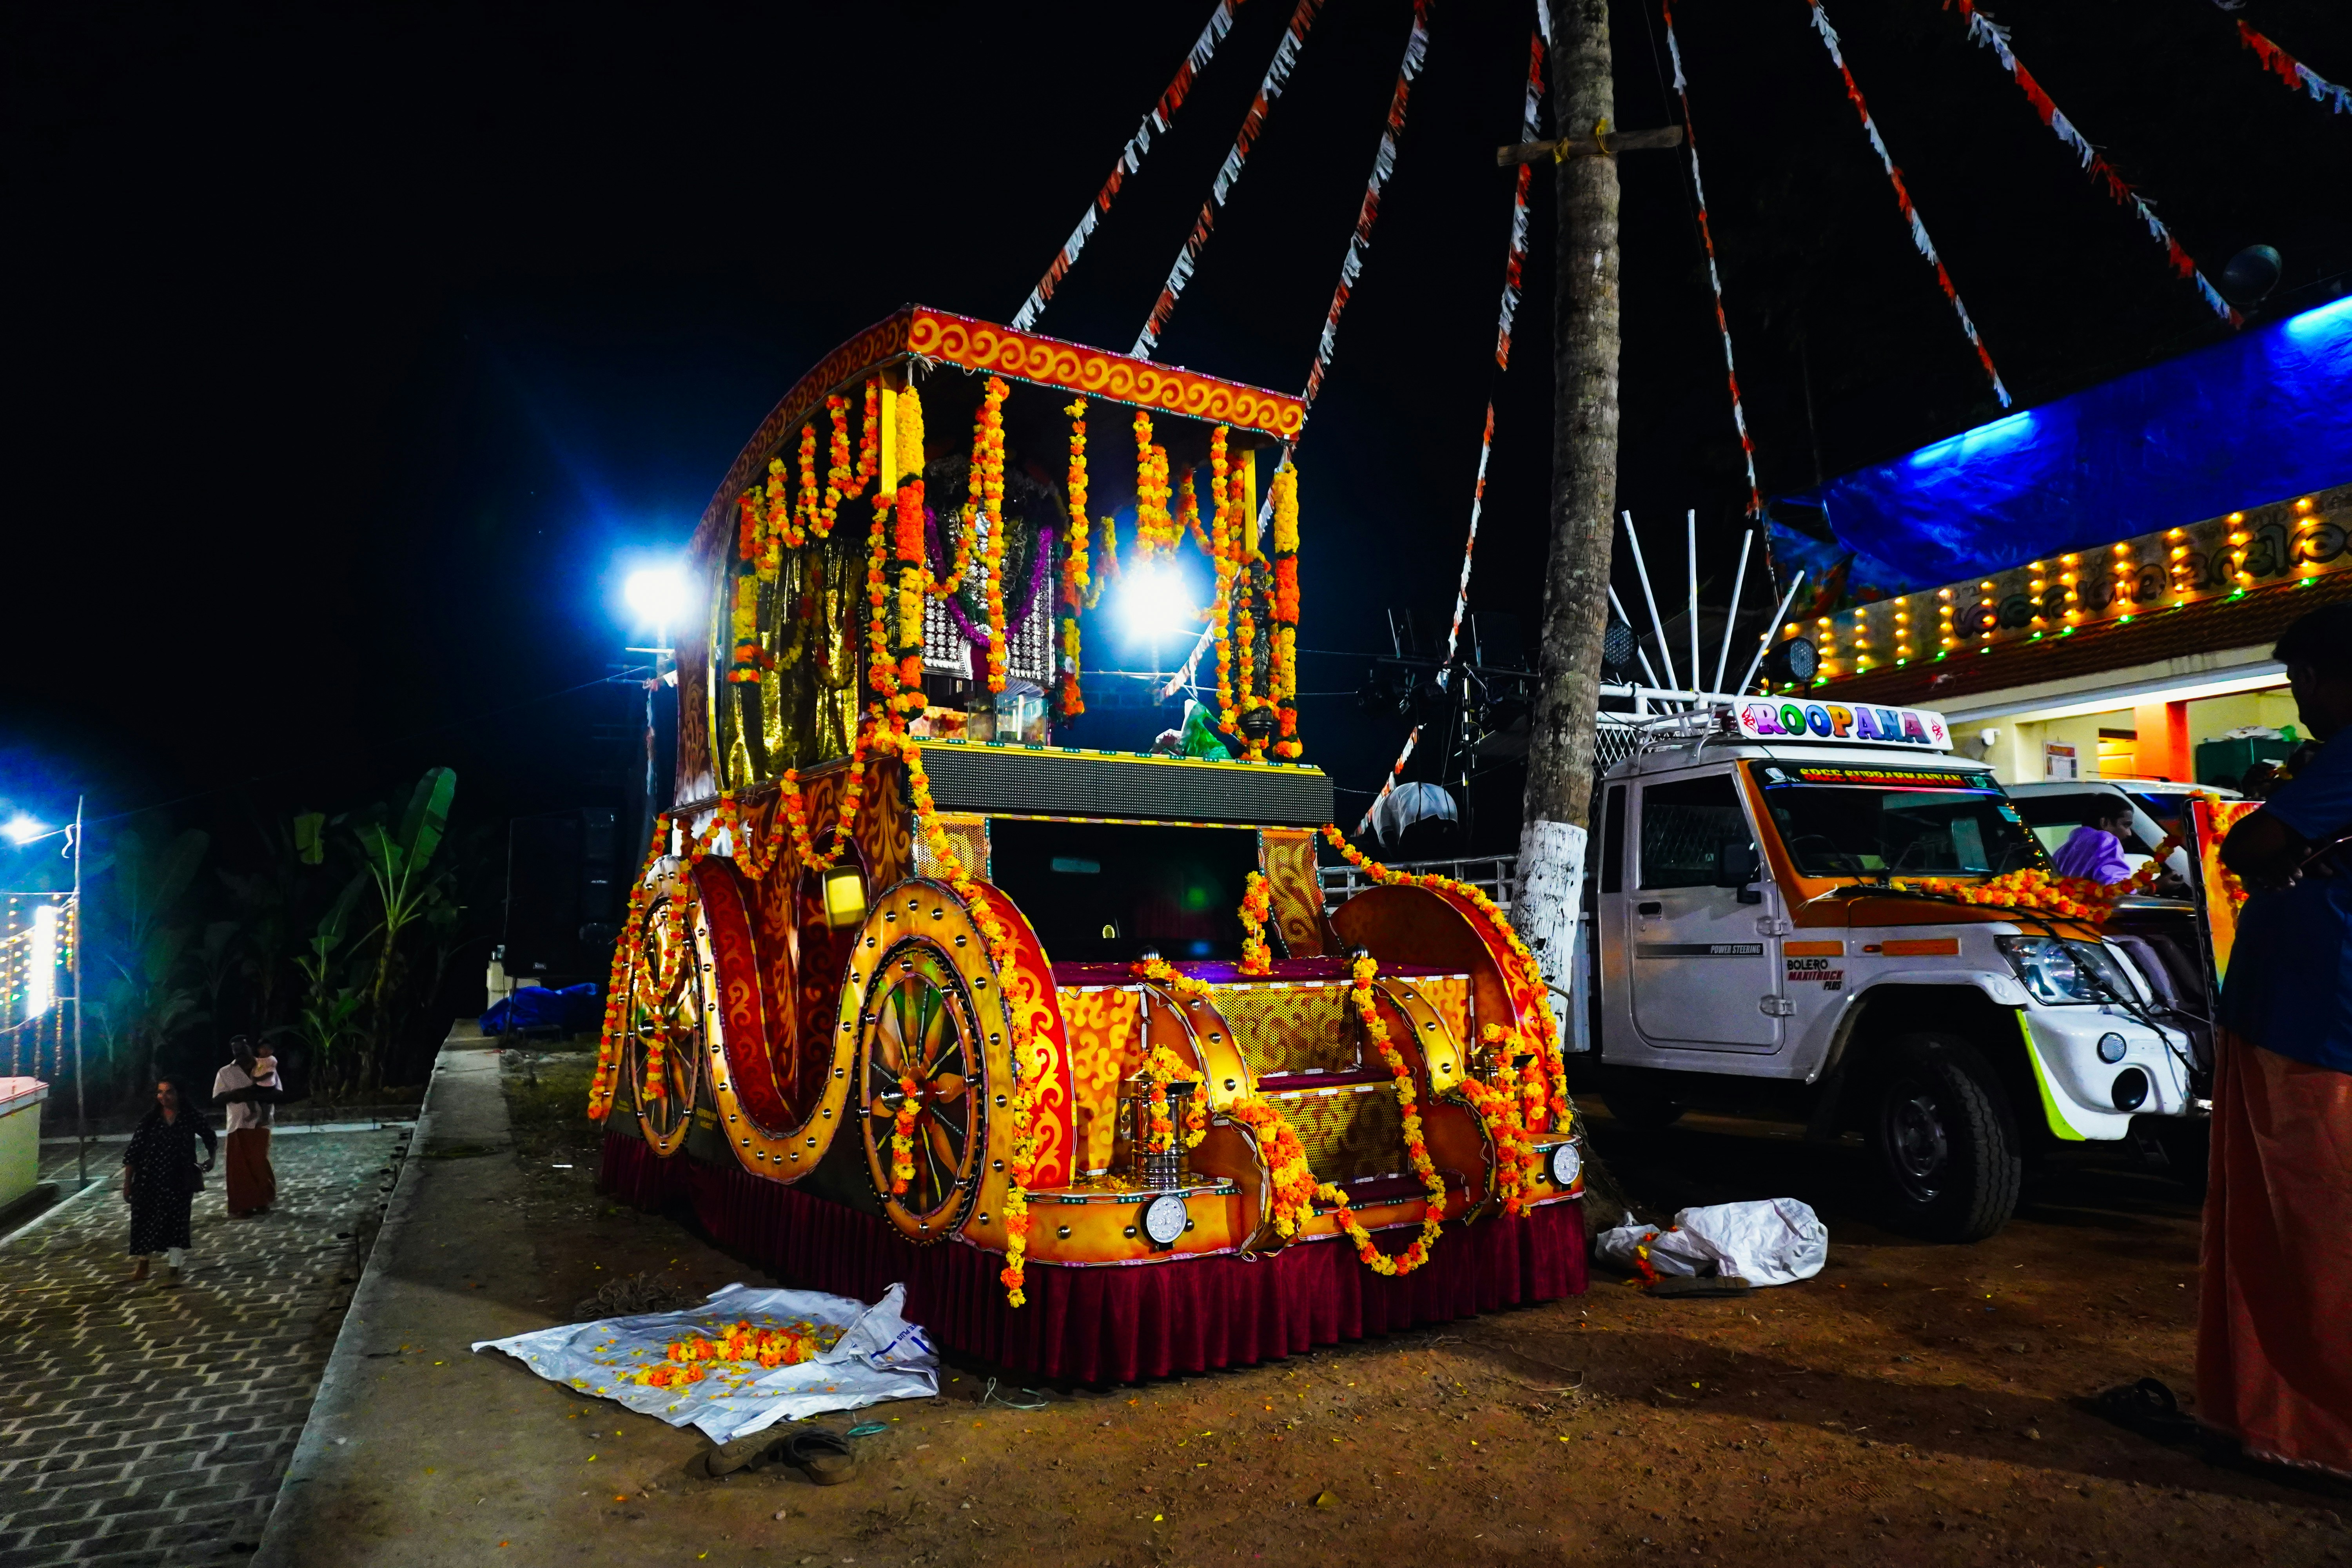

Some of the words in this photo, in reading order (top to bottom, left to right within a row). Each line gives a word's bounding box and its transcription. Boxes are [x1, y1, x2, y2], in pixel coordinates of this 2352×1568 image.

[2171, 522, 2352, 591] മന്ദിര
[1749, 704, 1932, 744] ROOPANA
[1800, 768, 1846, 781] SREE
[1711, 945, 1731, 954] POWER
[1732, 945, 1761, 954] STEERING
[1787, 959, 1828, 971] BOLERO
[1788, 970, 1843, 981] MAXITRUCK
[1824, 981, 1842, 990] PLUS
[897, 1328, 910, 1341] PLUS
